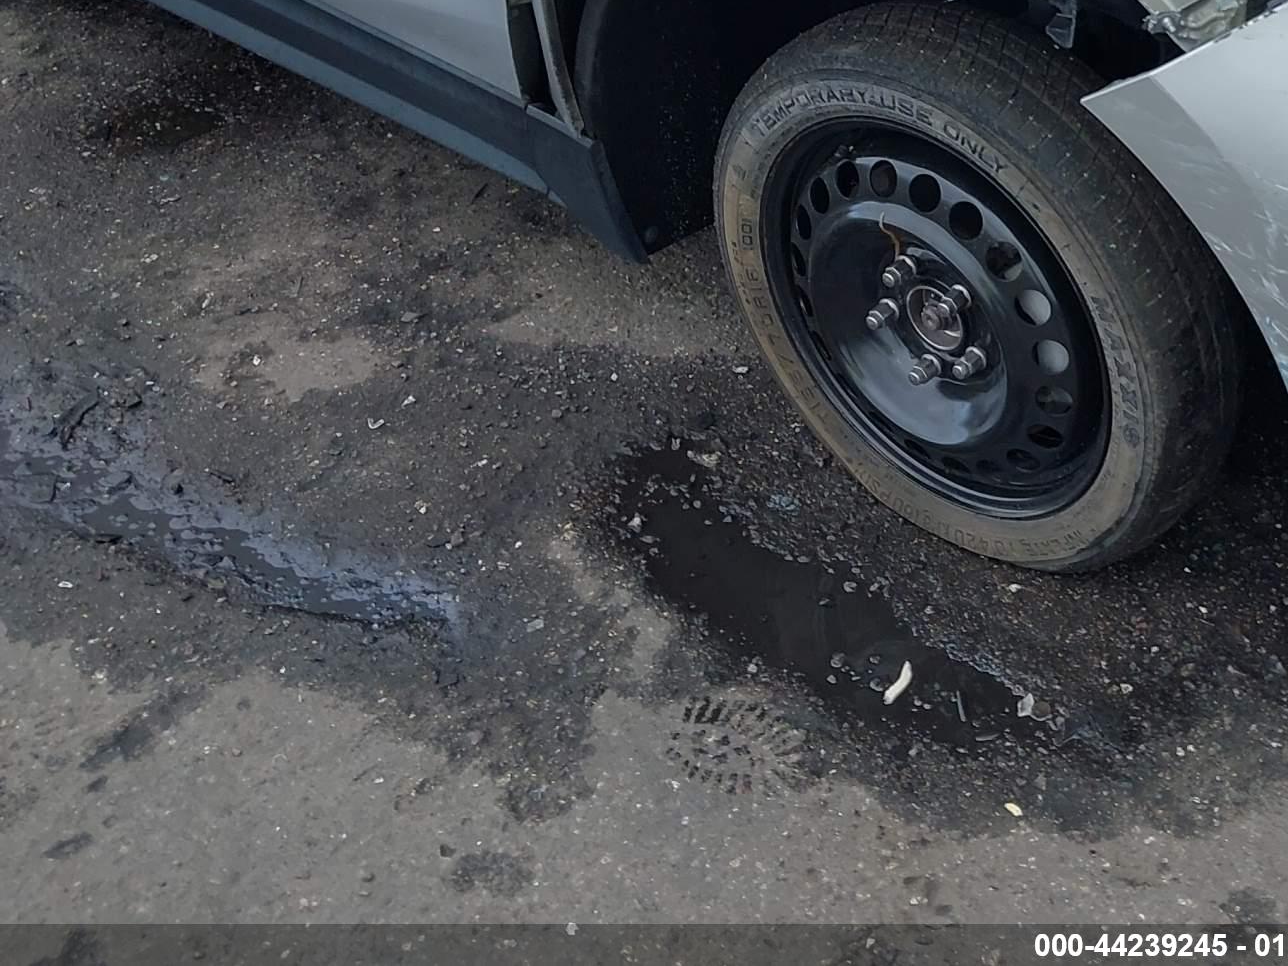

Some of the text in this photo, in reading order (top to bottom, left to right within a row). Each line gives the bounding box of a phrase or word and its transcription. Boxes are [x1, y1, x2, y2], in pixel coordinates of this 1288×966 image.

[753, 88, 1009, 175] TEMPORARY USE ONLY
